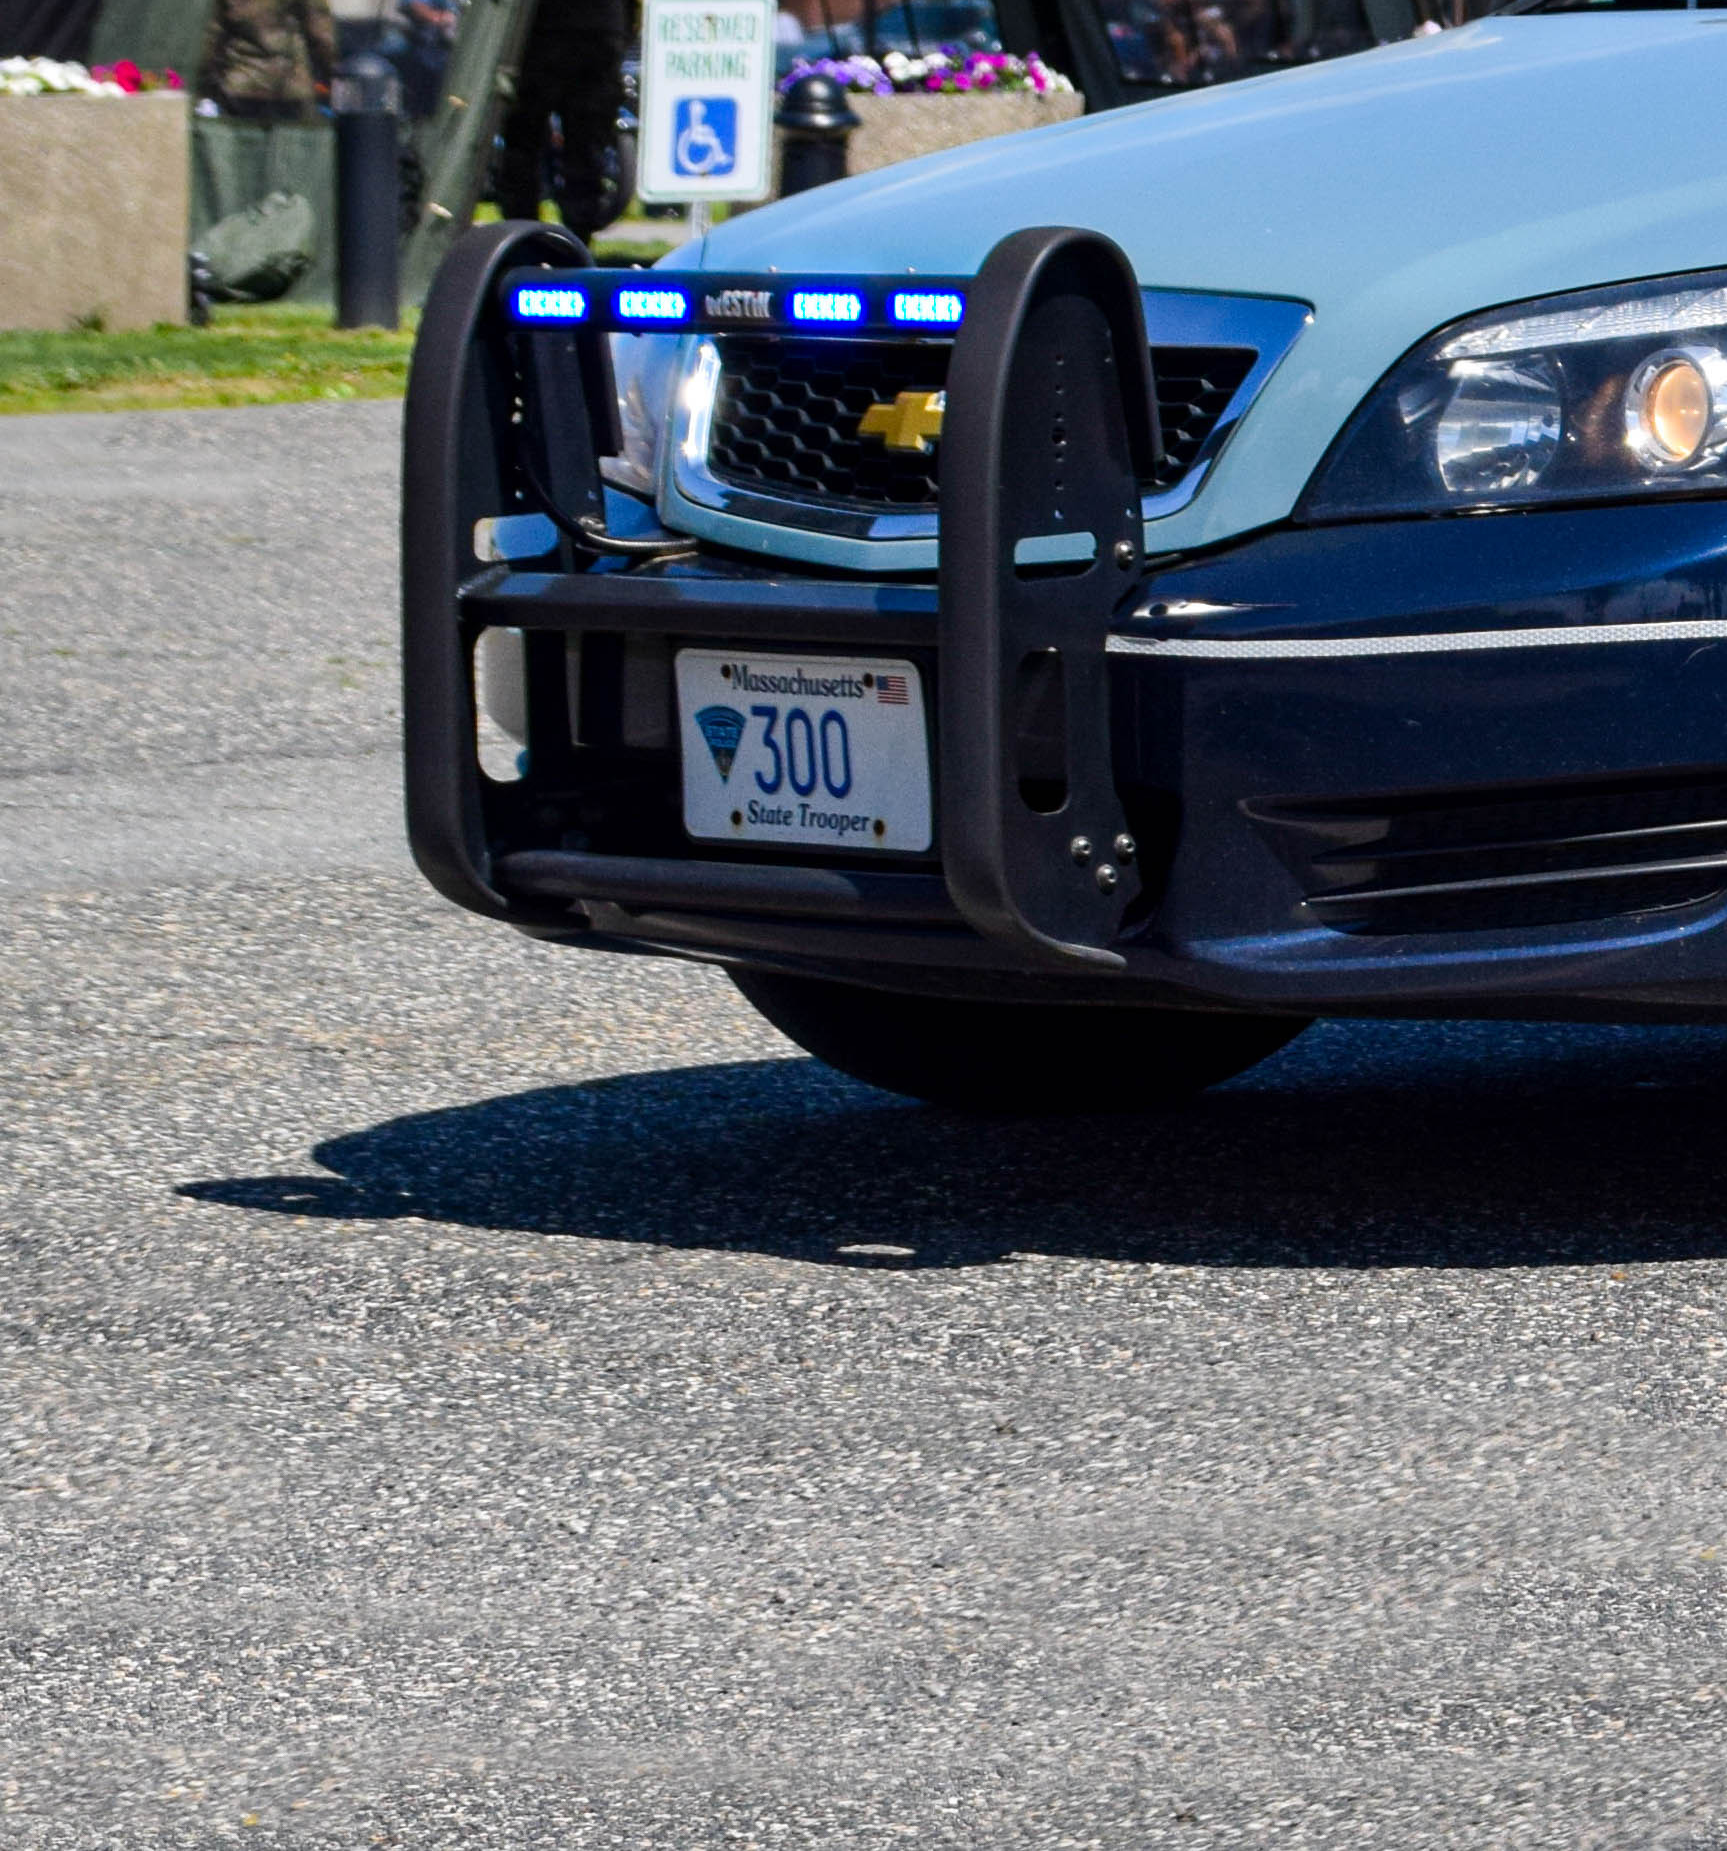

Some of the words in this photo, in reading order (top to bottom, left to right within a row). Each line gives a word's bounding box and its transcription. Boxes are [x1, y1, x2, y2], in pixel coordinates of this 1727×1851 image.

[657, 12, 759, 43] RESERVED
[665, 49, 748, 79] PARKING
[732, 663, 865, 699] Massachusetts
[750, 704, 852, 800] 300
[747, 799, 793, 827] State
[798, 804, 870, 836] Trooper
